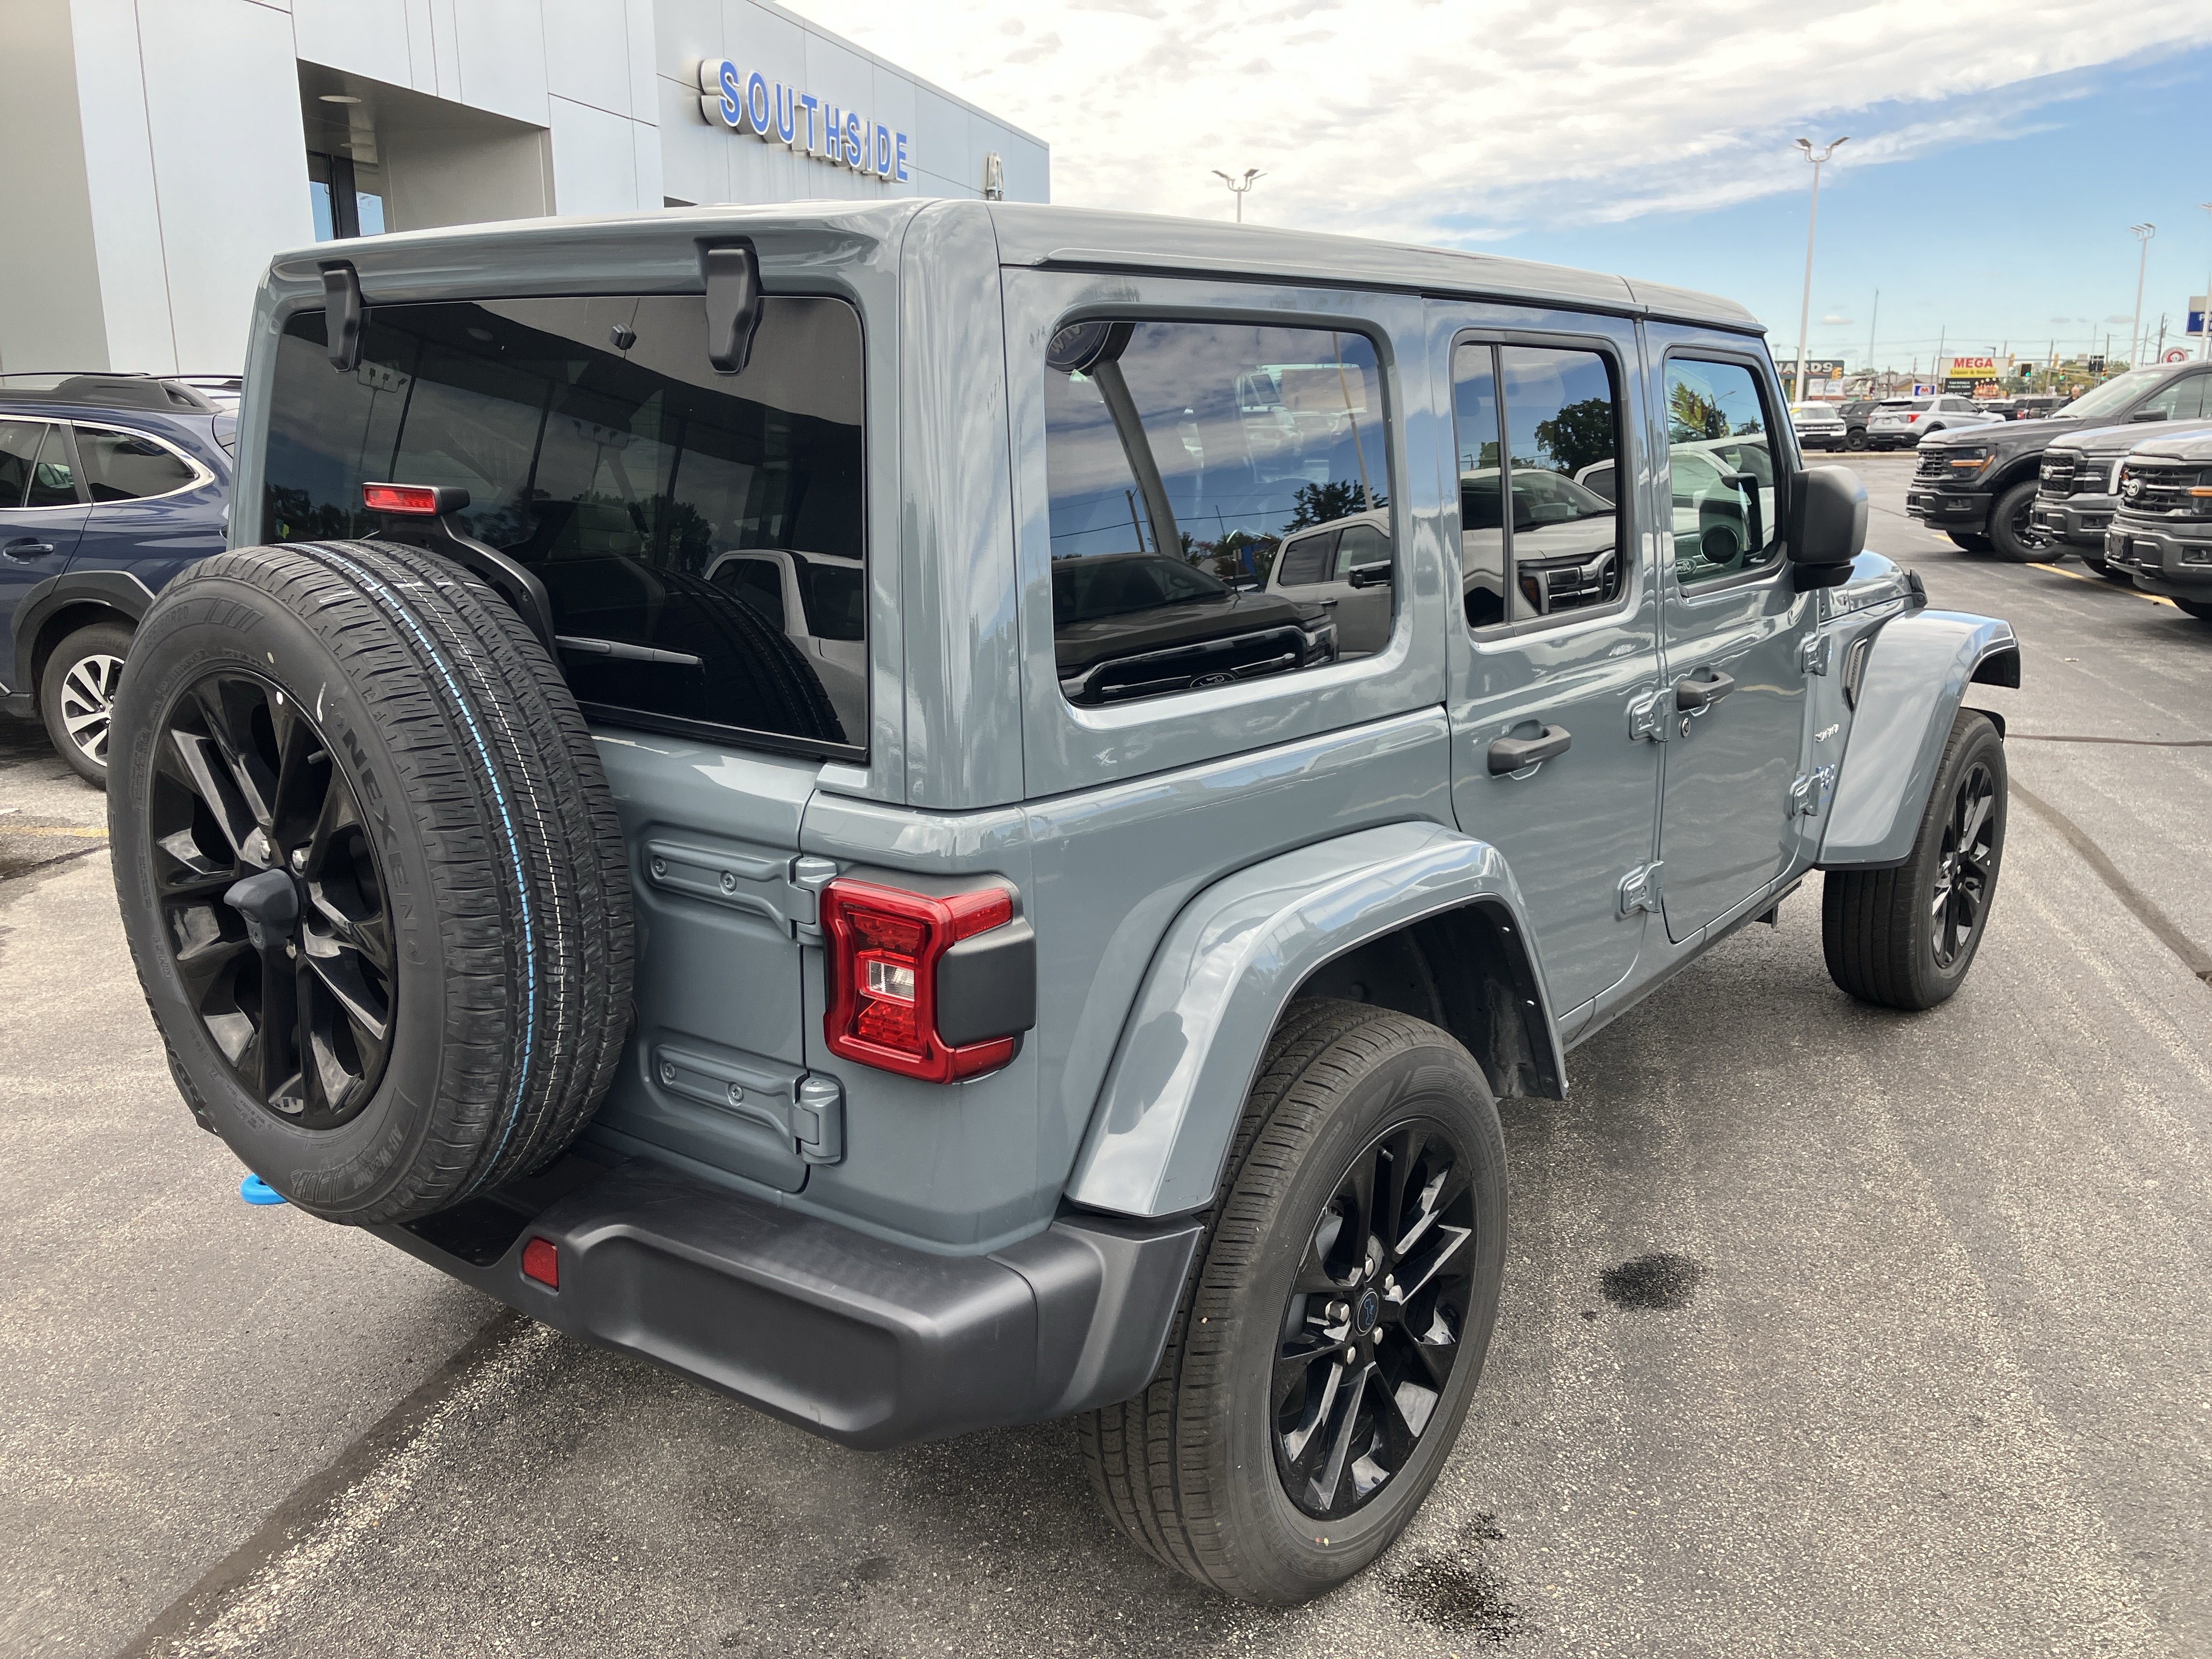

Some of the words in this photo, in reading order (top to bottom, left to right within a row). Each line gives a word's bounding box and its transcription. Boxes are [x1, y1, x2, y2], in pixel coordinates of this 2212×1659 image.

[716, 59, 909, 184] SOUTHSIDE
[1775, 362, 1833, 374] NADS
[1954, 358, 1994, 368] MEGA
[342, 727, 418, 931] NEXEN
